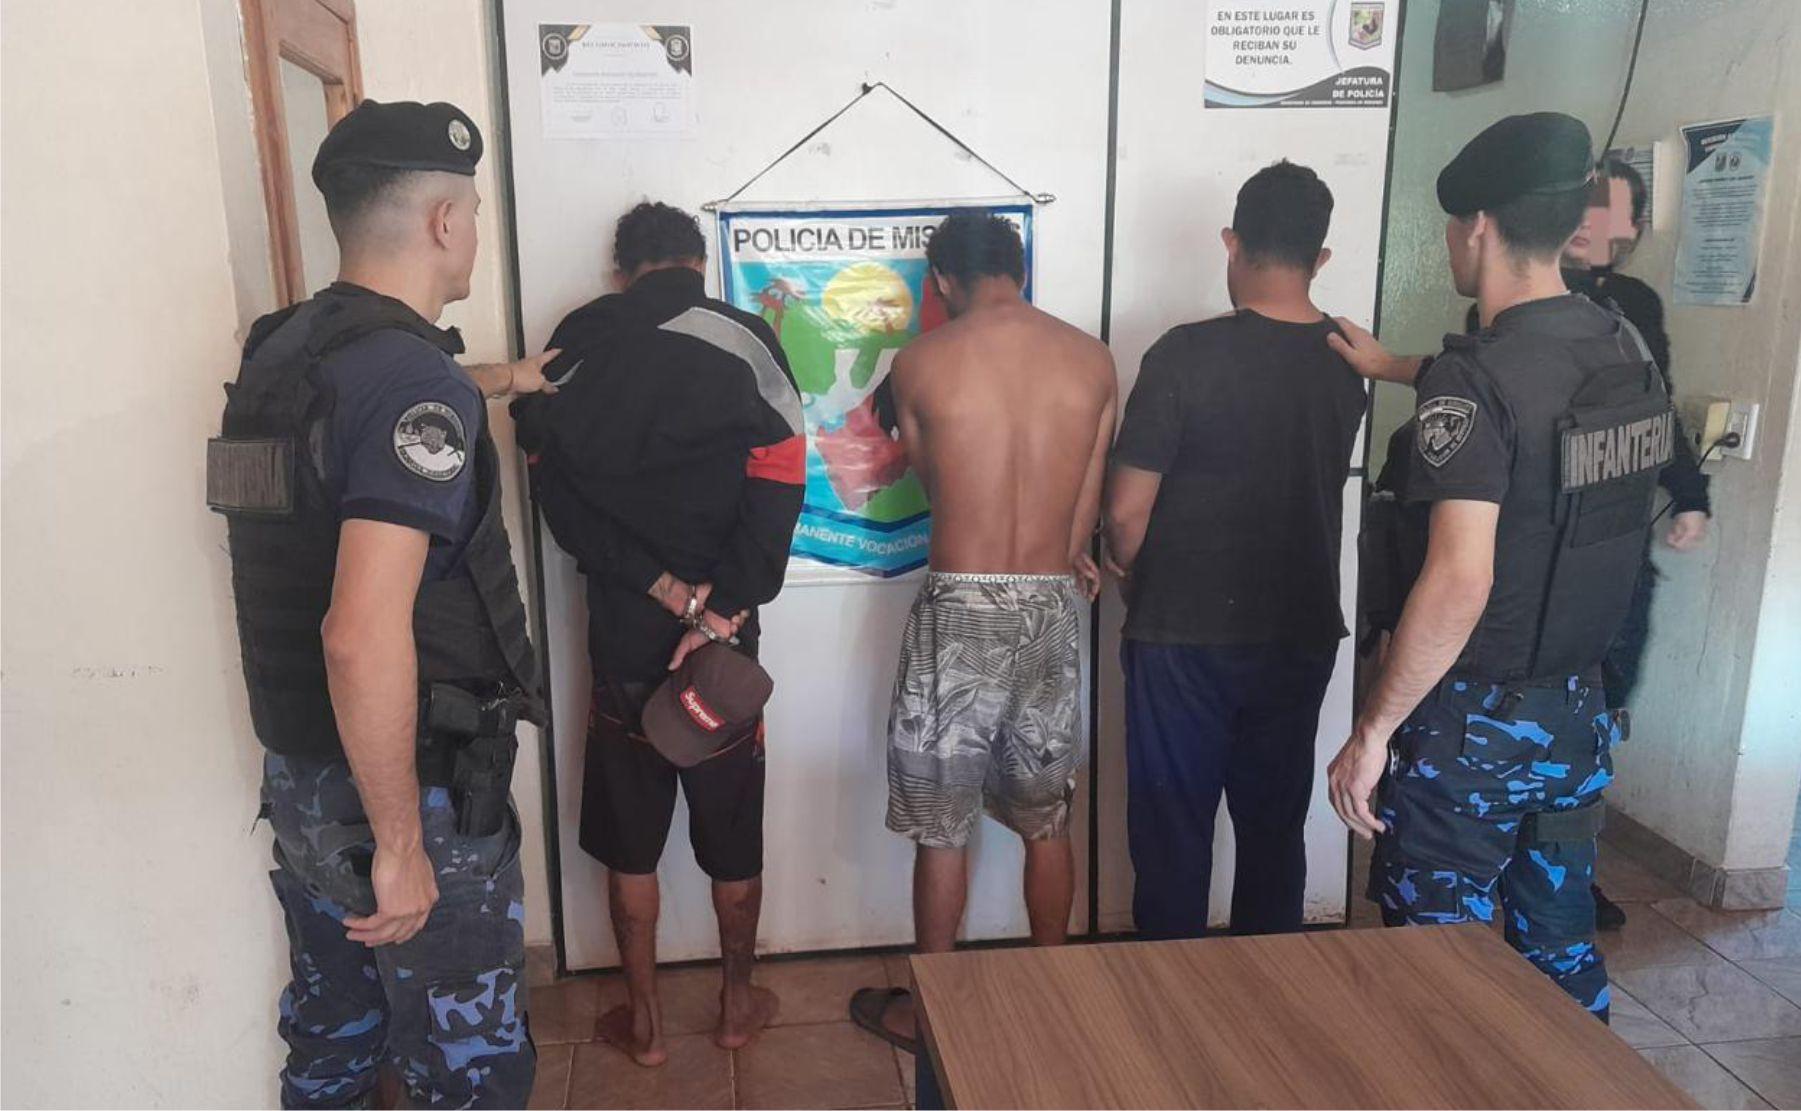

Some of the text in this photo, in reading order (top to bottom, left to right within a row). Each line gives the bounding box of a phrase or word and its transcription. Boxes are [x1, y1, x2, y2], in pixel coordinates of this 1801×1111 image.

[1217, 11, 1315, 21] EN ESTE LUGAR ES
[1211, 26, 1320, 36] OBLIGATORIO QUE LE
[1233, 41, 1297, 50] RECIBAN SU
[1235, 55, 1292, 65] DENUNCIA.
[1335, 77, 1383, 86] JEFATURA
[1332, 90, 1345, 98] DE
[734, 226, 844, 253] POLICIA
[848, 226, 885, 251] DE
[1570, 410, 1674, 488] INFANTERIA
[685, 690, 720, 729] Supreme
